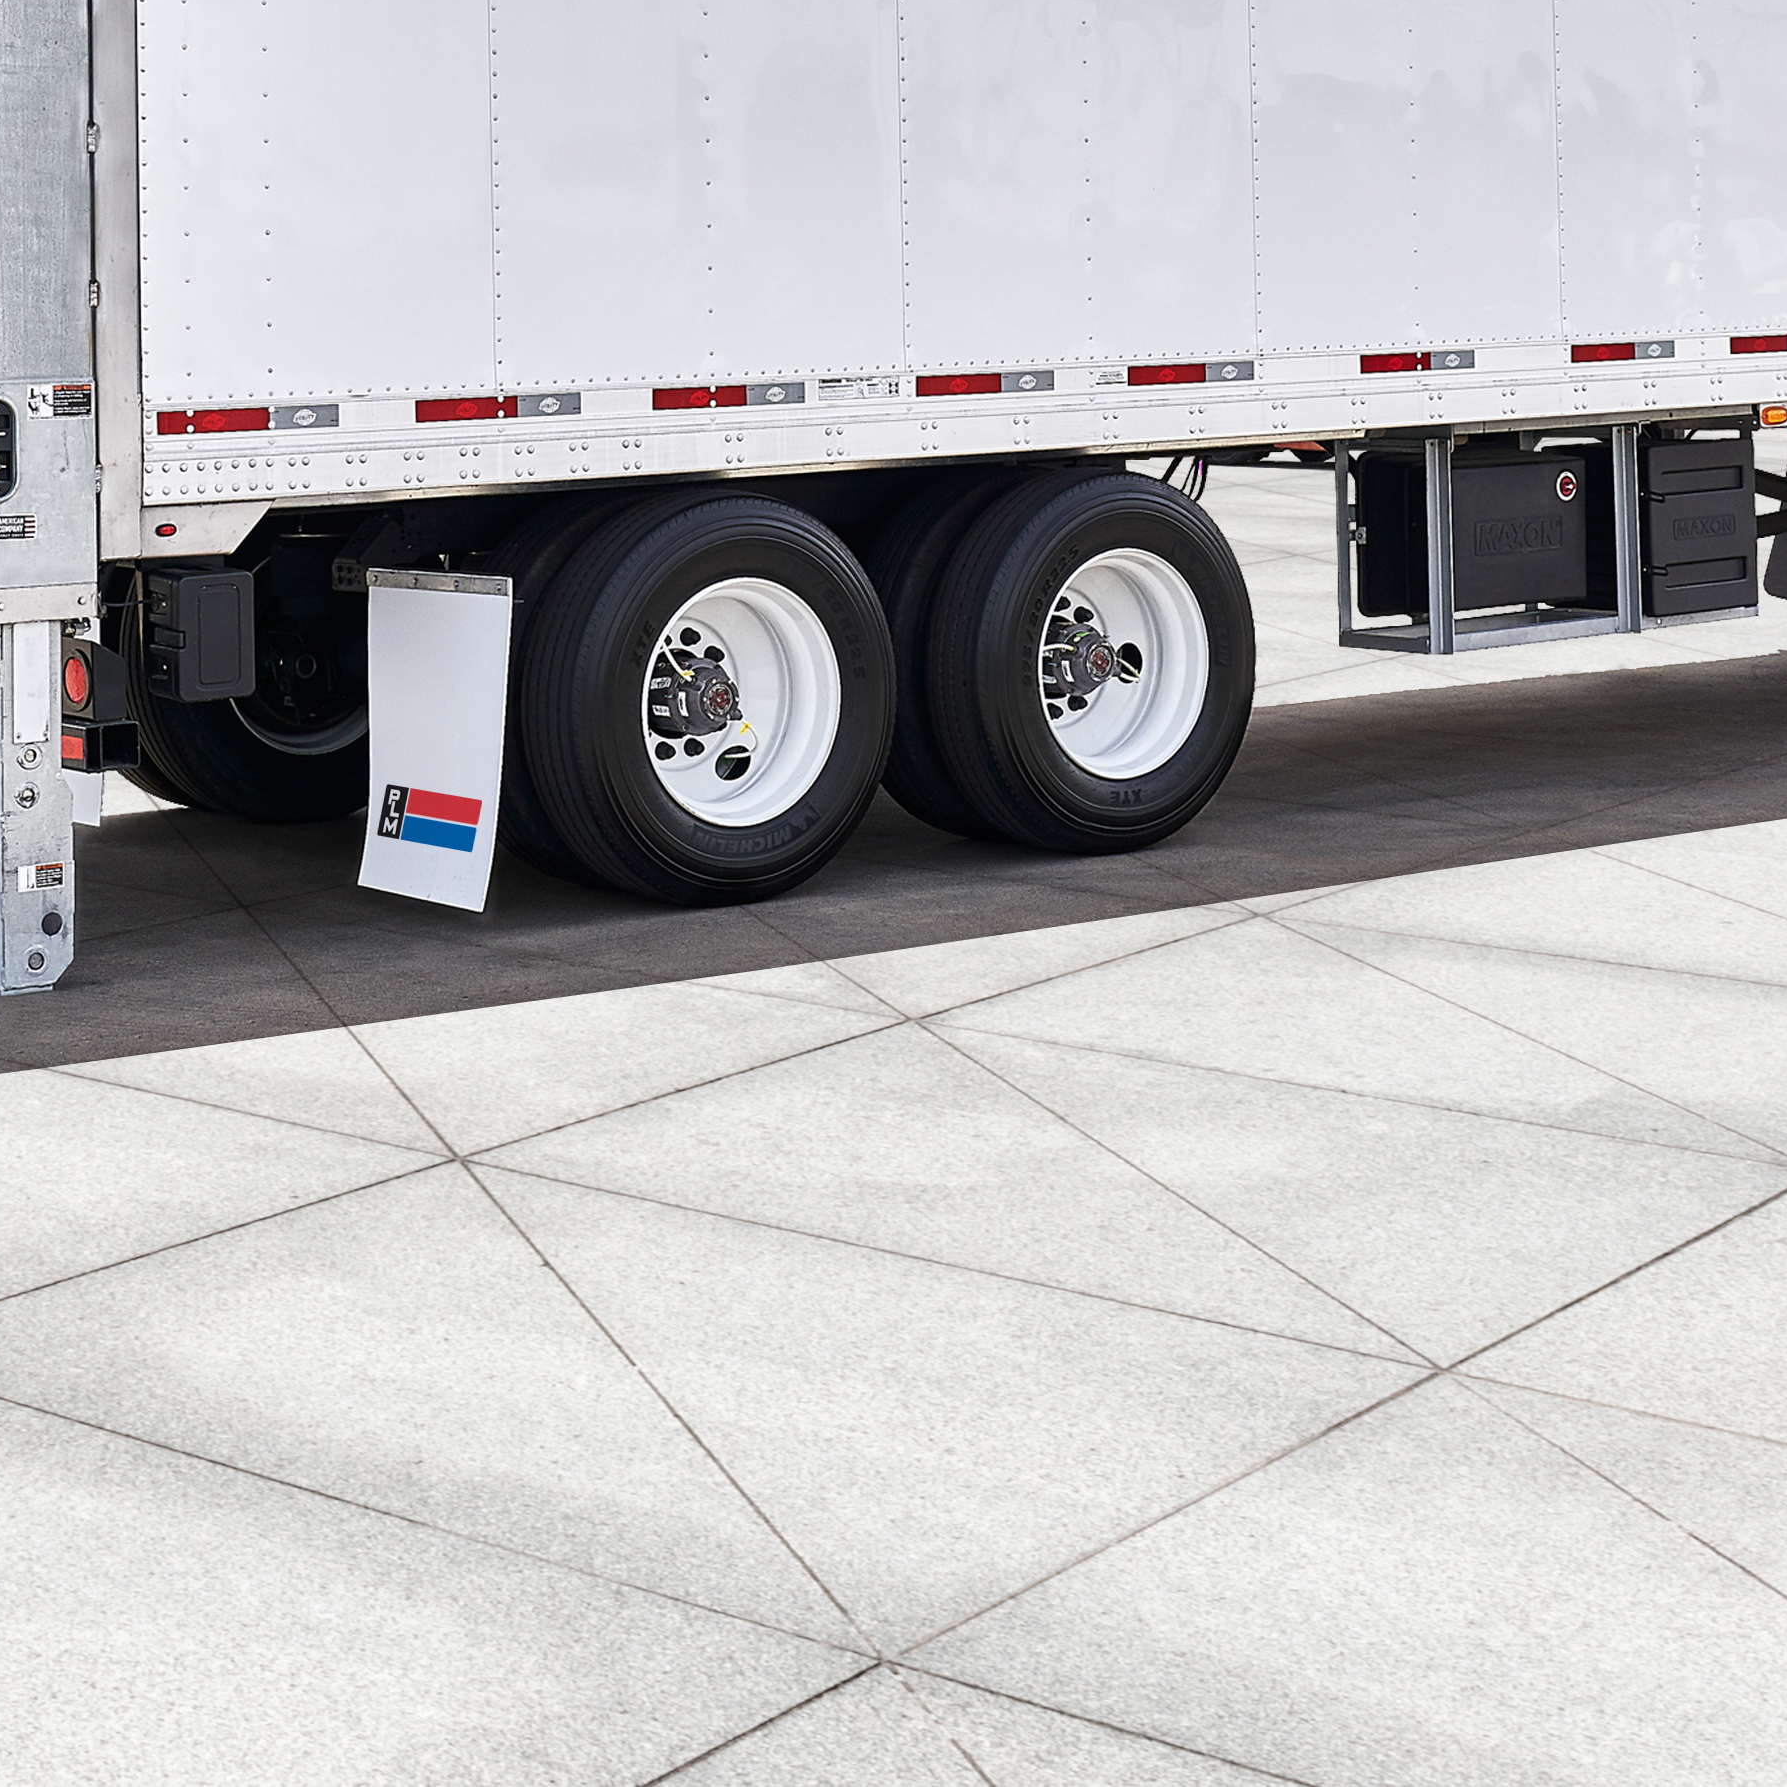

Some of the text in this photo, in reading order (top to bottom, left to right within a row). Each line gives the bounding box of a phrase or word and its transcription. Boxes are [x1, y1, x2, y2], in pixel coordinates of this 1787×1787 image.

[1478, 519, 1557, 552] MAXON
[1676, 517, 1732, 538] MAXON
[382, 788, 401, 835] PLM
[1109, 789, 1142, 806] XTE
[694, 823, 793, 854] MICHELIN
